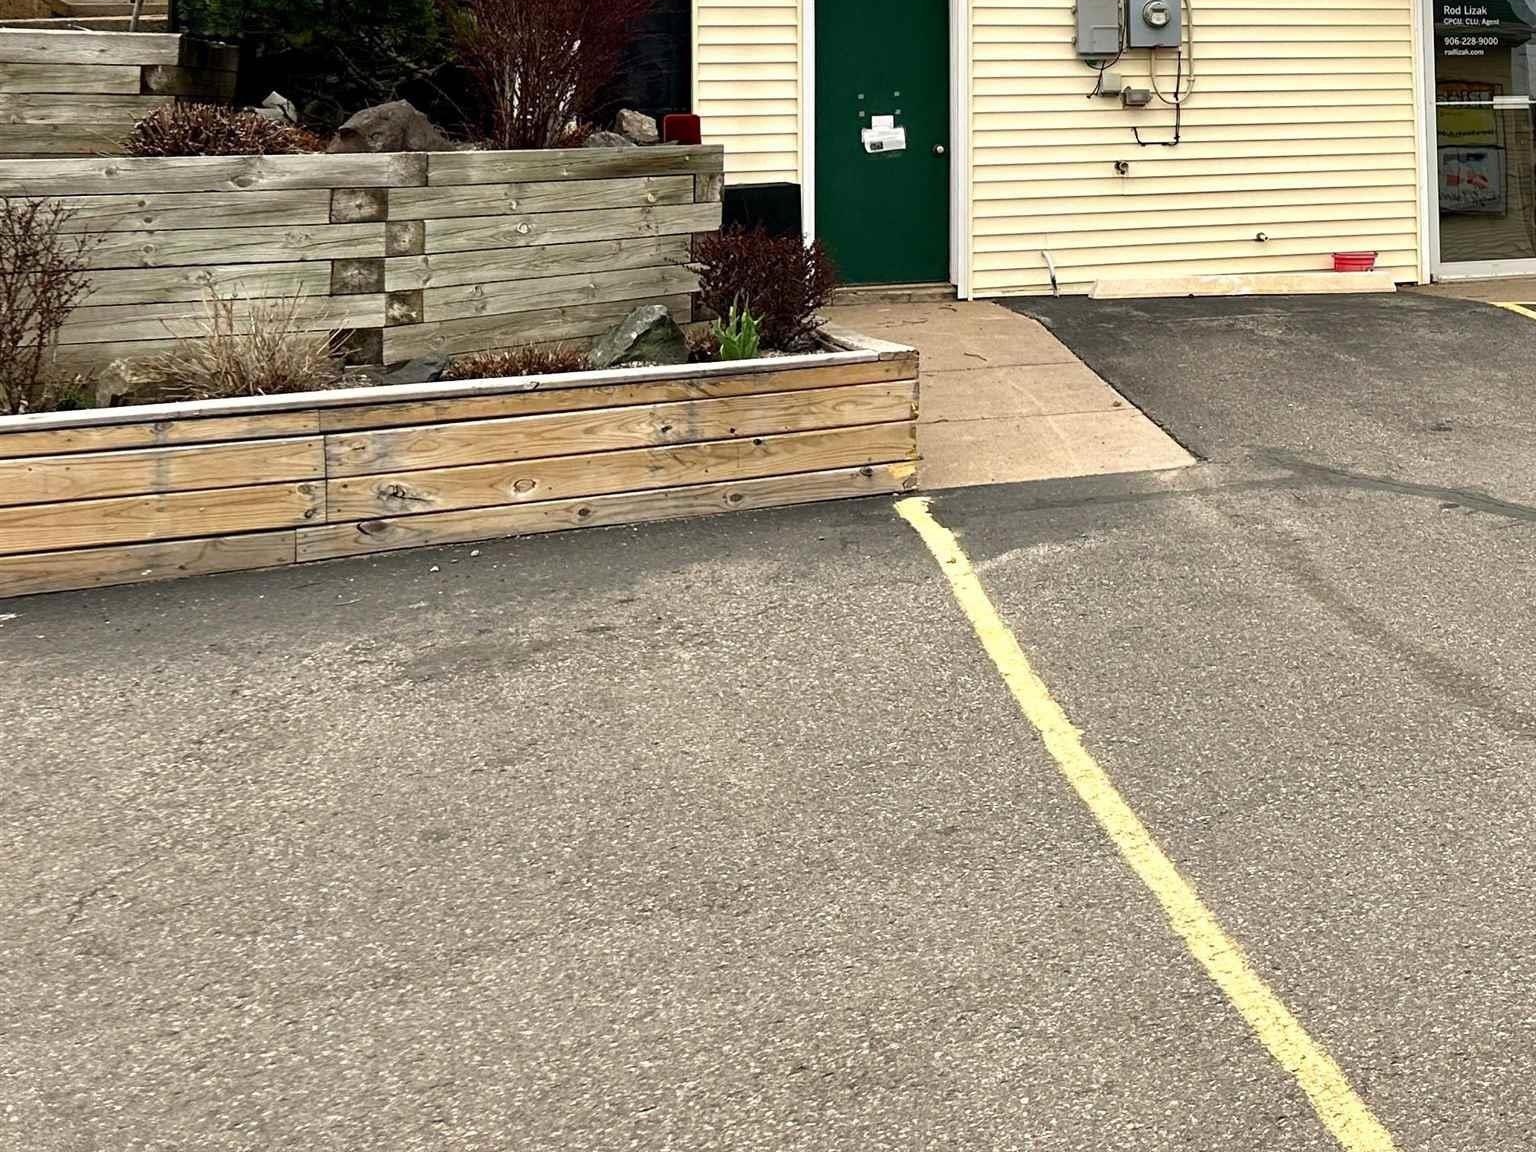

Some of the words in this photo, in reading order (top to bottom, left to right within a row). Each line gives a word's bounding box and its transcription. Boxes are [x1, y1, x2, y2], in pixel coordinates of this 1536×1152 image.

[1443, 5, 1461, 15] Rod
[1464, 5, 1488, 15] Lizak
[1444, 37, 1499, 46] 906-228-9000
